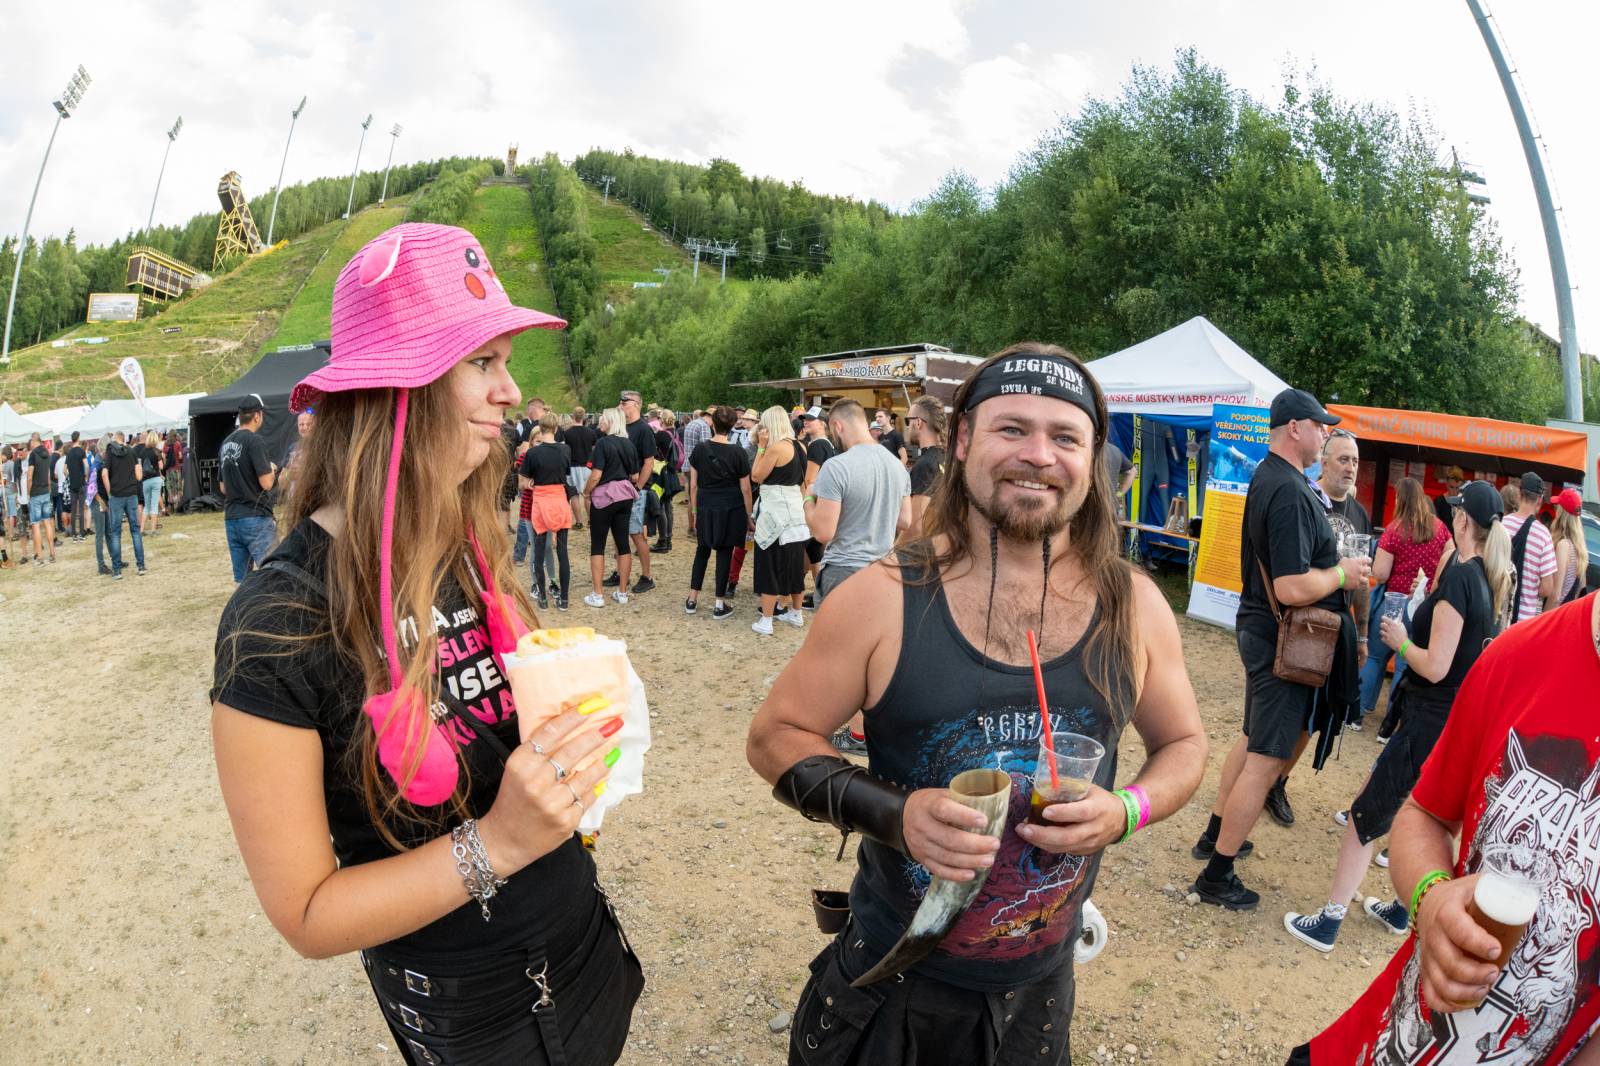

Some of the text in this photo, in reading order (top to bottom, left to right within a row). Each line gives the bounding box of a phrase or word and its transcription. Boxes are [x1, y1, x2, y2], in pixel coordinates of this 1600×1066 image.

[1003, 359, 1083, 389] LEGENDY
[1046, 375, 1056, 384] SE
[1358, 414, 1449, 440] CHAČAPURI
[1466, 422, 1551, 453] ČEBUREKY
[452, 607, 478, 627] JSEM
